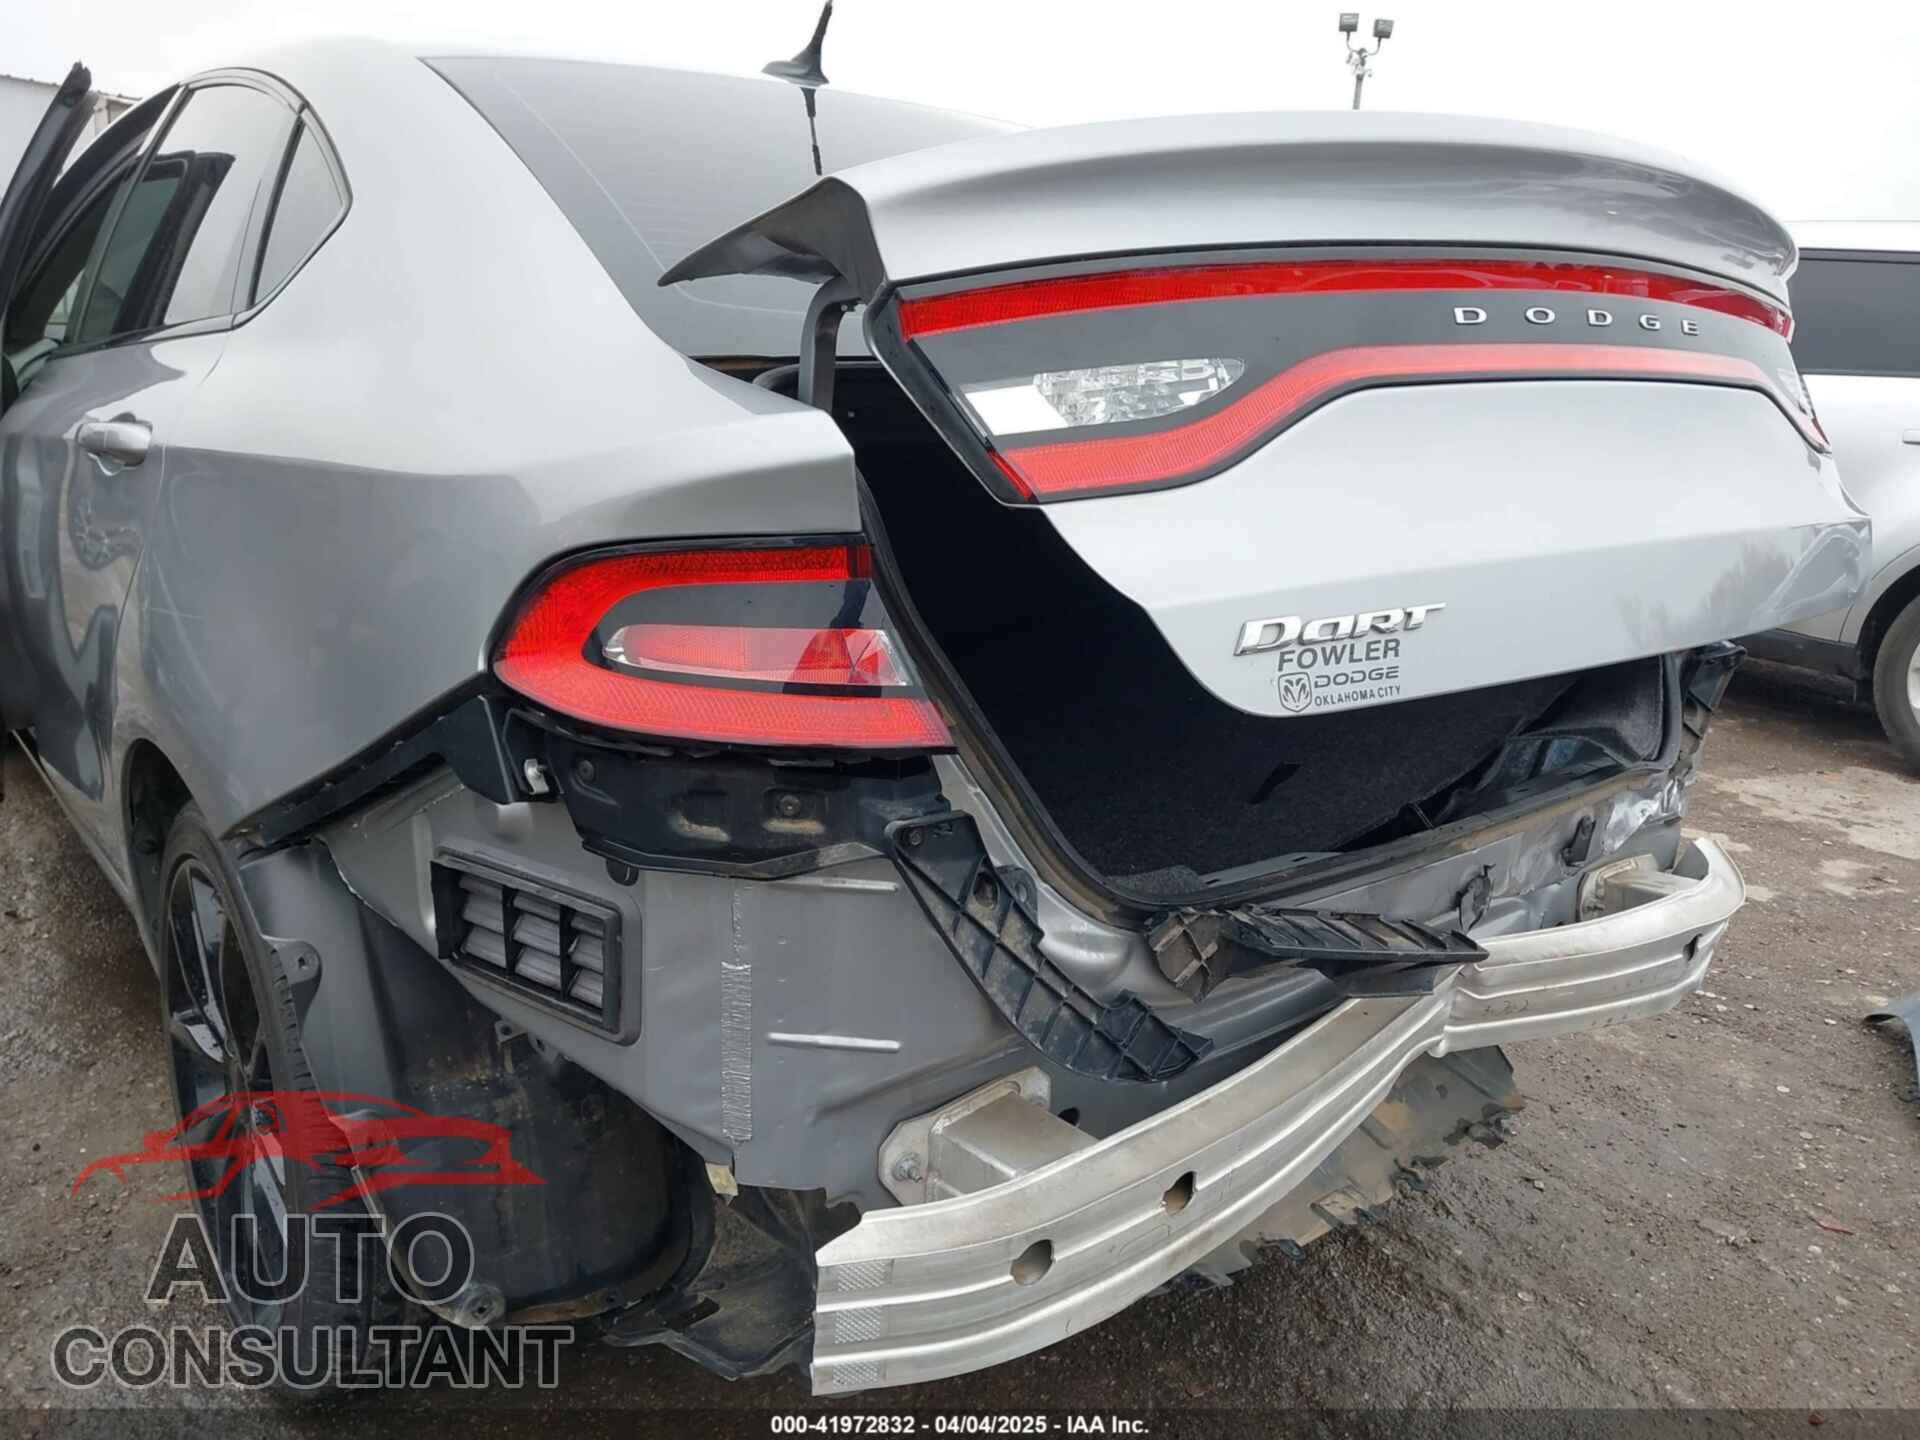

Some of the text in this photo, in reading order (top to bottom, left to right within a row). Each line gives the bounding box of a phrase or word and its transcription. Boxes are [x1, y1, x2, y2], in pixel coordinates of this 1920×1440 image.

[1453, 306, 1702, 337] DODGE
[1277, 638, 1401, 672] FOWLER
[1314, 666, 1399, 689] DODGE
[1314, 684, 1401, 707] OKLAHOMA CITY
